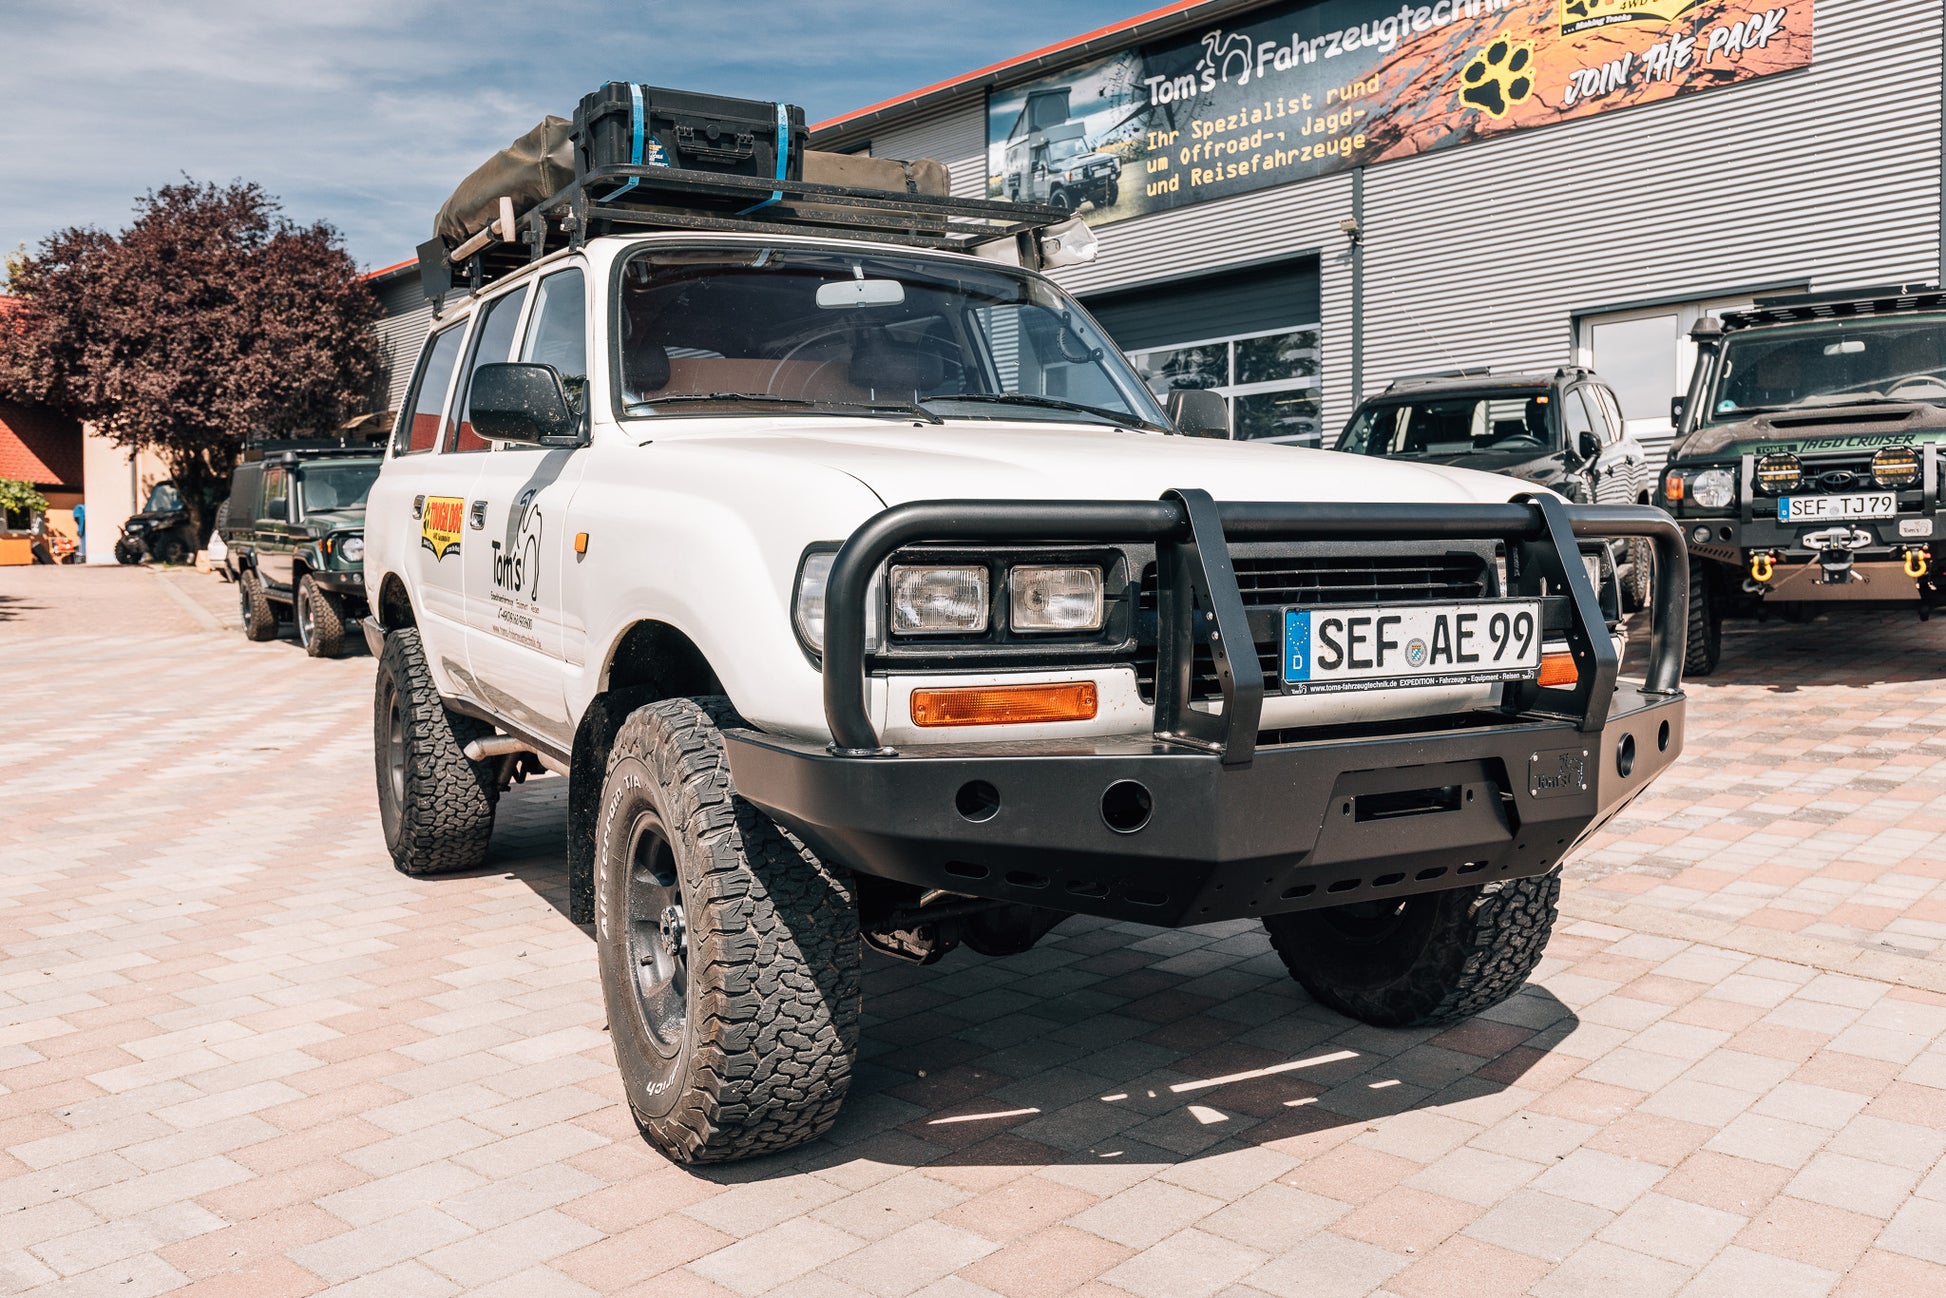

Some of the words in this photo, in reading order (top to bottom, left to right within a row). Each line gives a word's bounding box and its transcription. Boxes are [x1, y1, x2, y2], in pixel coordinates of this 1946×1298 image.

[1144, 59, 1216, 105] Tom's
[1564, 51, 1634, 105] JOIN
[1641, 32, 1697, 83] THE
[1706, 7, 1787, 63] PACK
[1147, 131, 1180, 151] Ihr
[1191, 93, 1312, 139] Spezialist
[1326, 74, 1380, 104] rund
[1147, 156, 1169, 174] um
[1180, 128, 1286, 165] Offroad-,
[1302, 107, 1366, 136] Jagd-
[1147, 174, 1180, 197] und
[1191, 132, 1367, 187] Reisefahrzeuge
[430, 502, 451, 531] TOUGH
[448, 502, 463, 534] DOG
[1792, 499, 1828, 516] SEF
[1840, 498, 1865, 513] TJ
[1869, 496, 1892, 513] 79
[492, 540, 522, 592] Tom's
[1293, 655, 1303, 669] D
[1318, 615, 1402, 671] SEF
[1430, 613, 1480, 665] AE
[1489, 611, 1534, 661] 99
[1310, 681, 1398, 693] www.toms-fahrzeugtechnik.de
[1400, 677, 1435, 687] EXPEDITION
[1438, 676, 1467, 685] Fahrzeuge
[1471, 674, 1499, 683] Equipment
[1502, 671, 1520, 680] Reisen
[601, 788, 624, 939] All-Terrain
[624, 774, 641, 789] T/A
